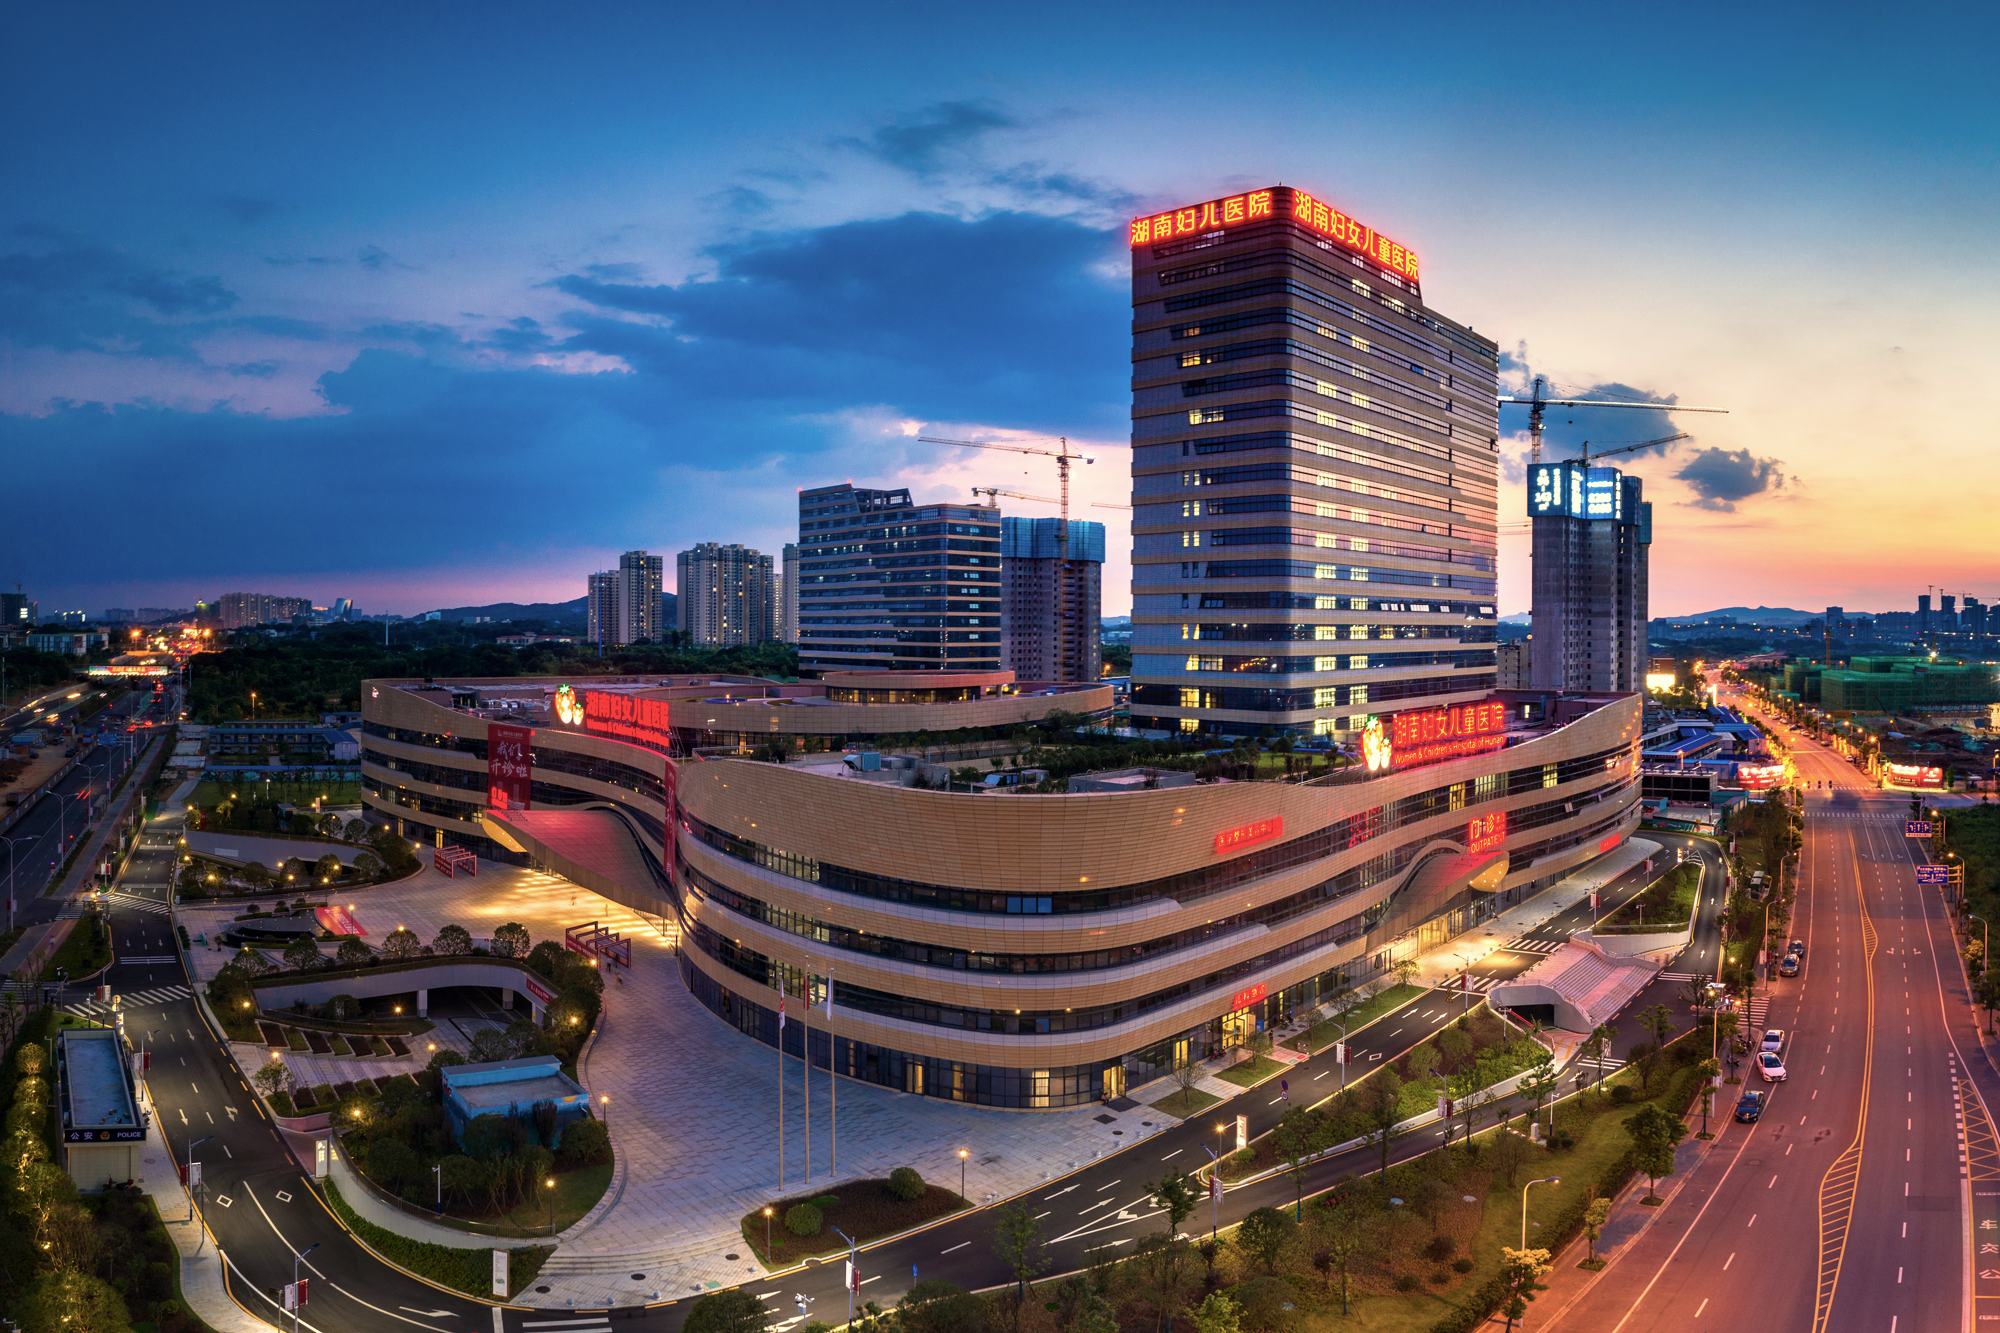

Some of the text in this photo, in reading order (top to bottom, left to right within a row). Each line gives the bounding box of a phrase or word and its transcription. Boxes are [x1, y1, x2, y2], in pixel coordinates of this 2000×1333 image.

[1131, 192, 1271, 245] 湖南妇儿医院
[1294, 190, 1419, 281] 湖南妇女儿童医院
[1393, 703, 1505, 746] 湖南妇女儿童医院
[496, 741, 522, 761] 我们
[1395, 752, 1417, 765] Women
[1470, 813, 1495, 840] 门诊
[70, 1131, 142, 1141] 公安 POLICE
